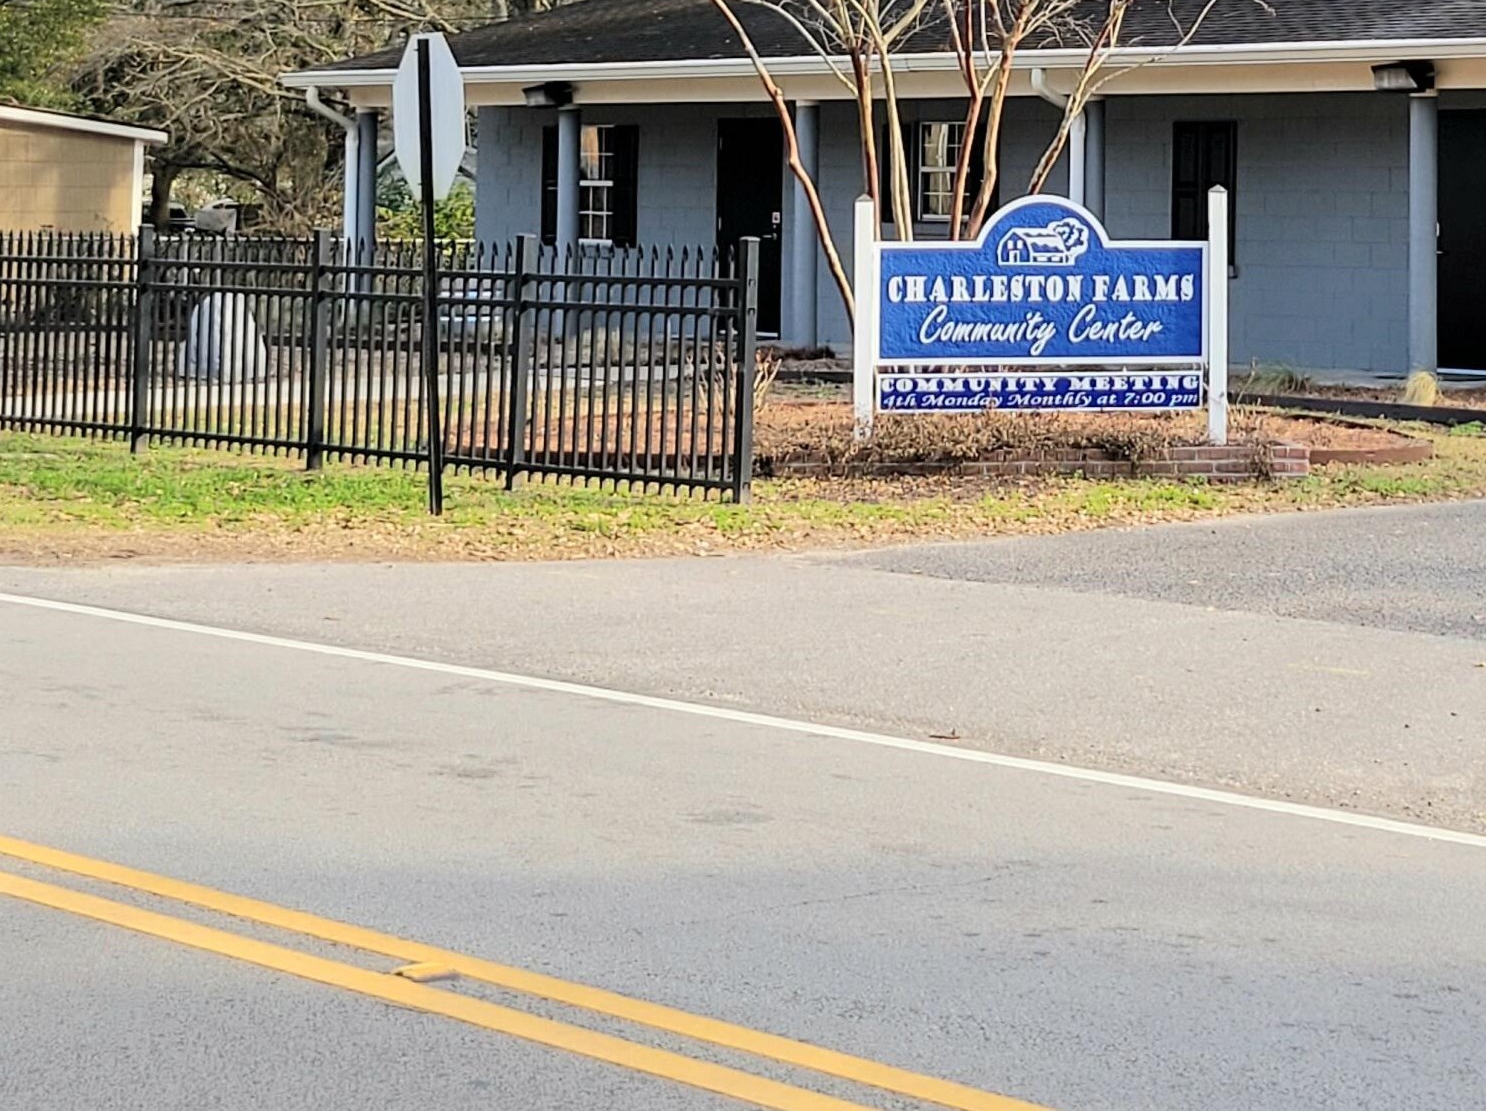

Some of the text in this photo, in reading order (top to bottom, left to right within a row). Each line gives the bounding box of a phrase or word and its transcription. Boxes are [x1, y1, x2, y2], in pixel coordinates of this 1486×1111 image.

[888, 274, 1195, 303] CHARLESTON FARMS
[919, 305, 1163, 355] Community Center
[882, 376, 1199, 393] COMMUNITY MEETING
[883, 392, 1198, 409] 4th Monday Monthly at 7:00 pm
